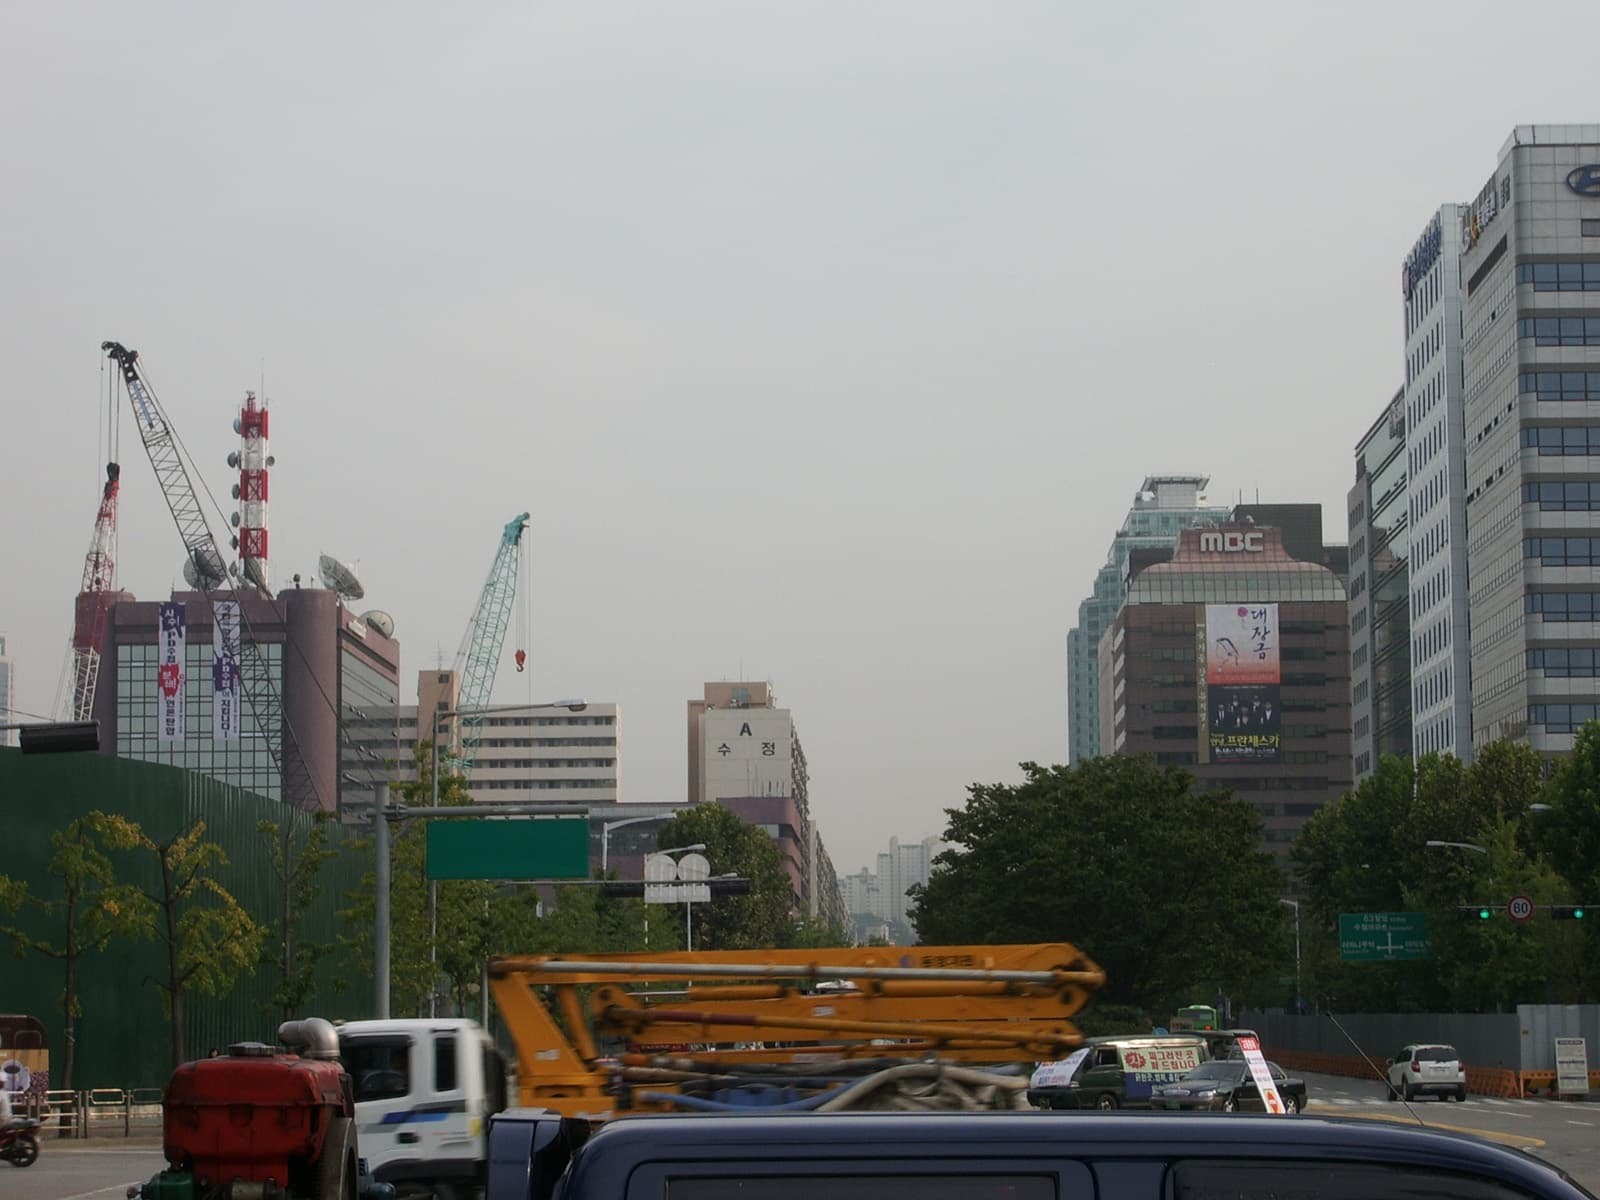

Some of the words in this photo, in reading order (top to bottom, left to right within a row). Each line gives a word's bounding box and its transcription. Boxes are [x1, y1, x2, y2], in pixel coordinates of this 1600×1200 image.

[1250, 607, 1272, 660] 대장금
[167, 631, 176, 663] PD수첩
[739, 722, 752, 736] A
[1227, 735, 1280, 748] 프란체스카
[1185, 1050, 1194, 1060] 곳
[1162, 1059, 1196, 1070] 드립니다
